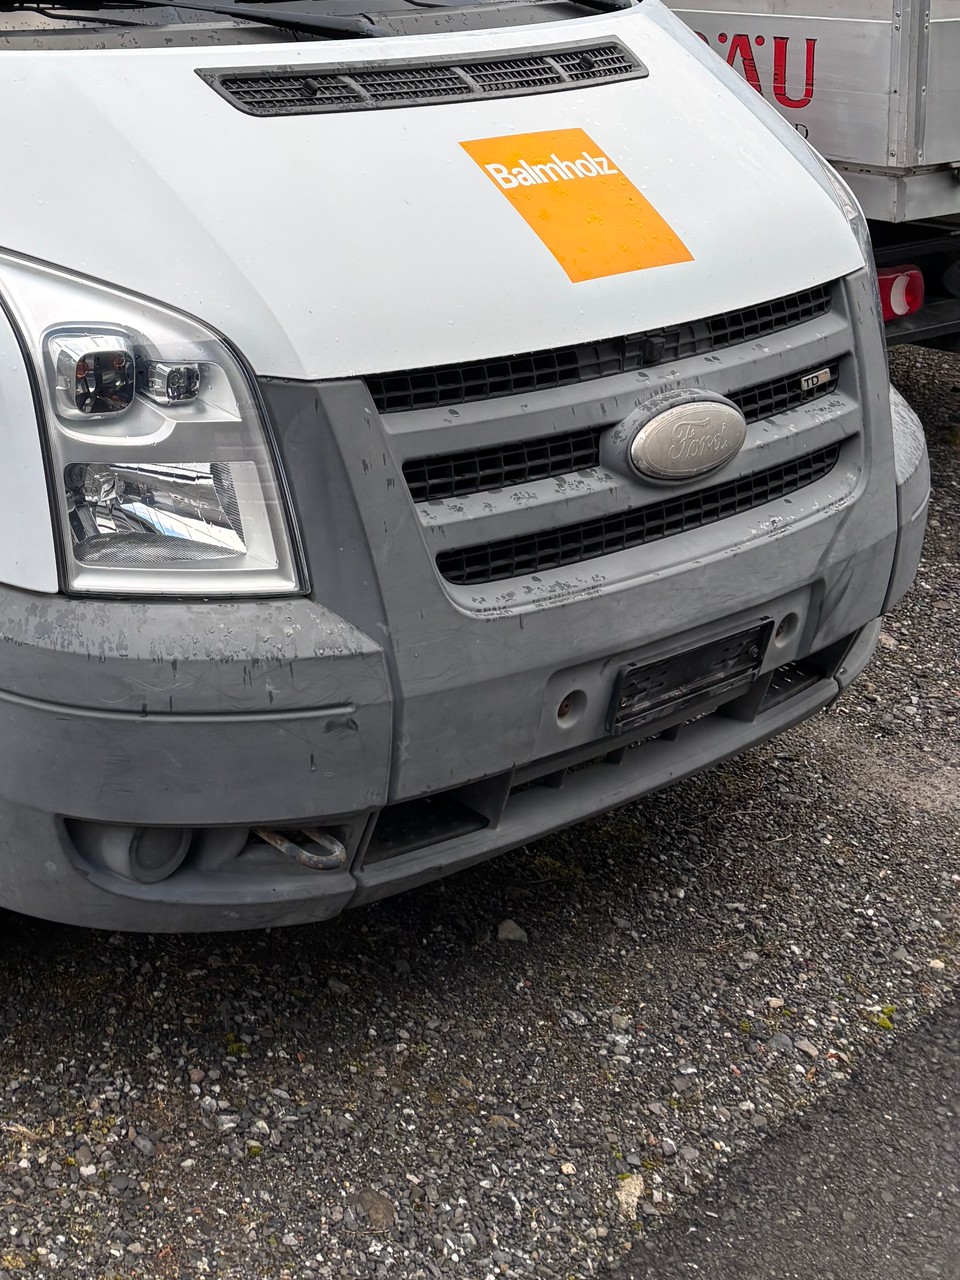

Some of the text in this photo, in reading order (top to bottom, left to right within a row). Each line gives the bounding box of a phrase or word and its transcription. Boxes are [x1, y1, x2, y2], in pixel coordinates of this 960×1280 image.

[694, 31, 818, 109] ÄU
[484, 152, 619, 190] Balmholz
[669, 417, 728, 460] Ford
